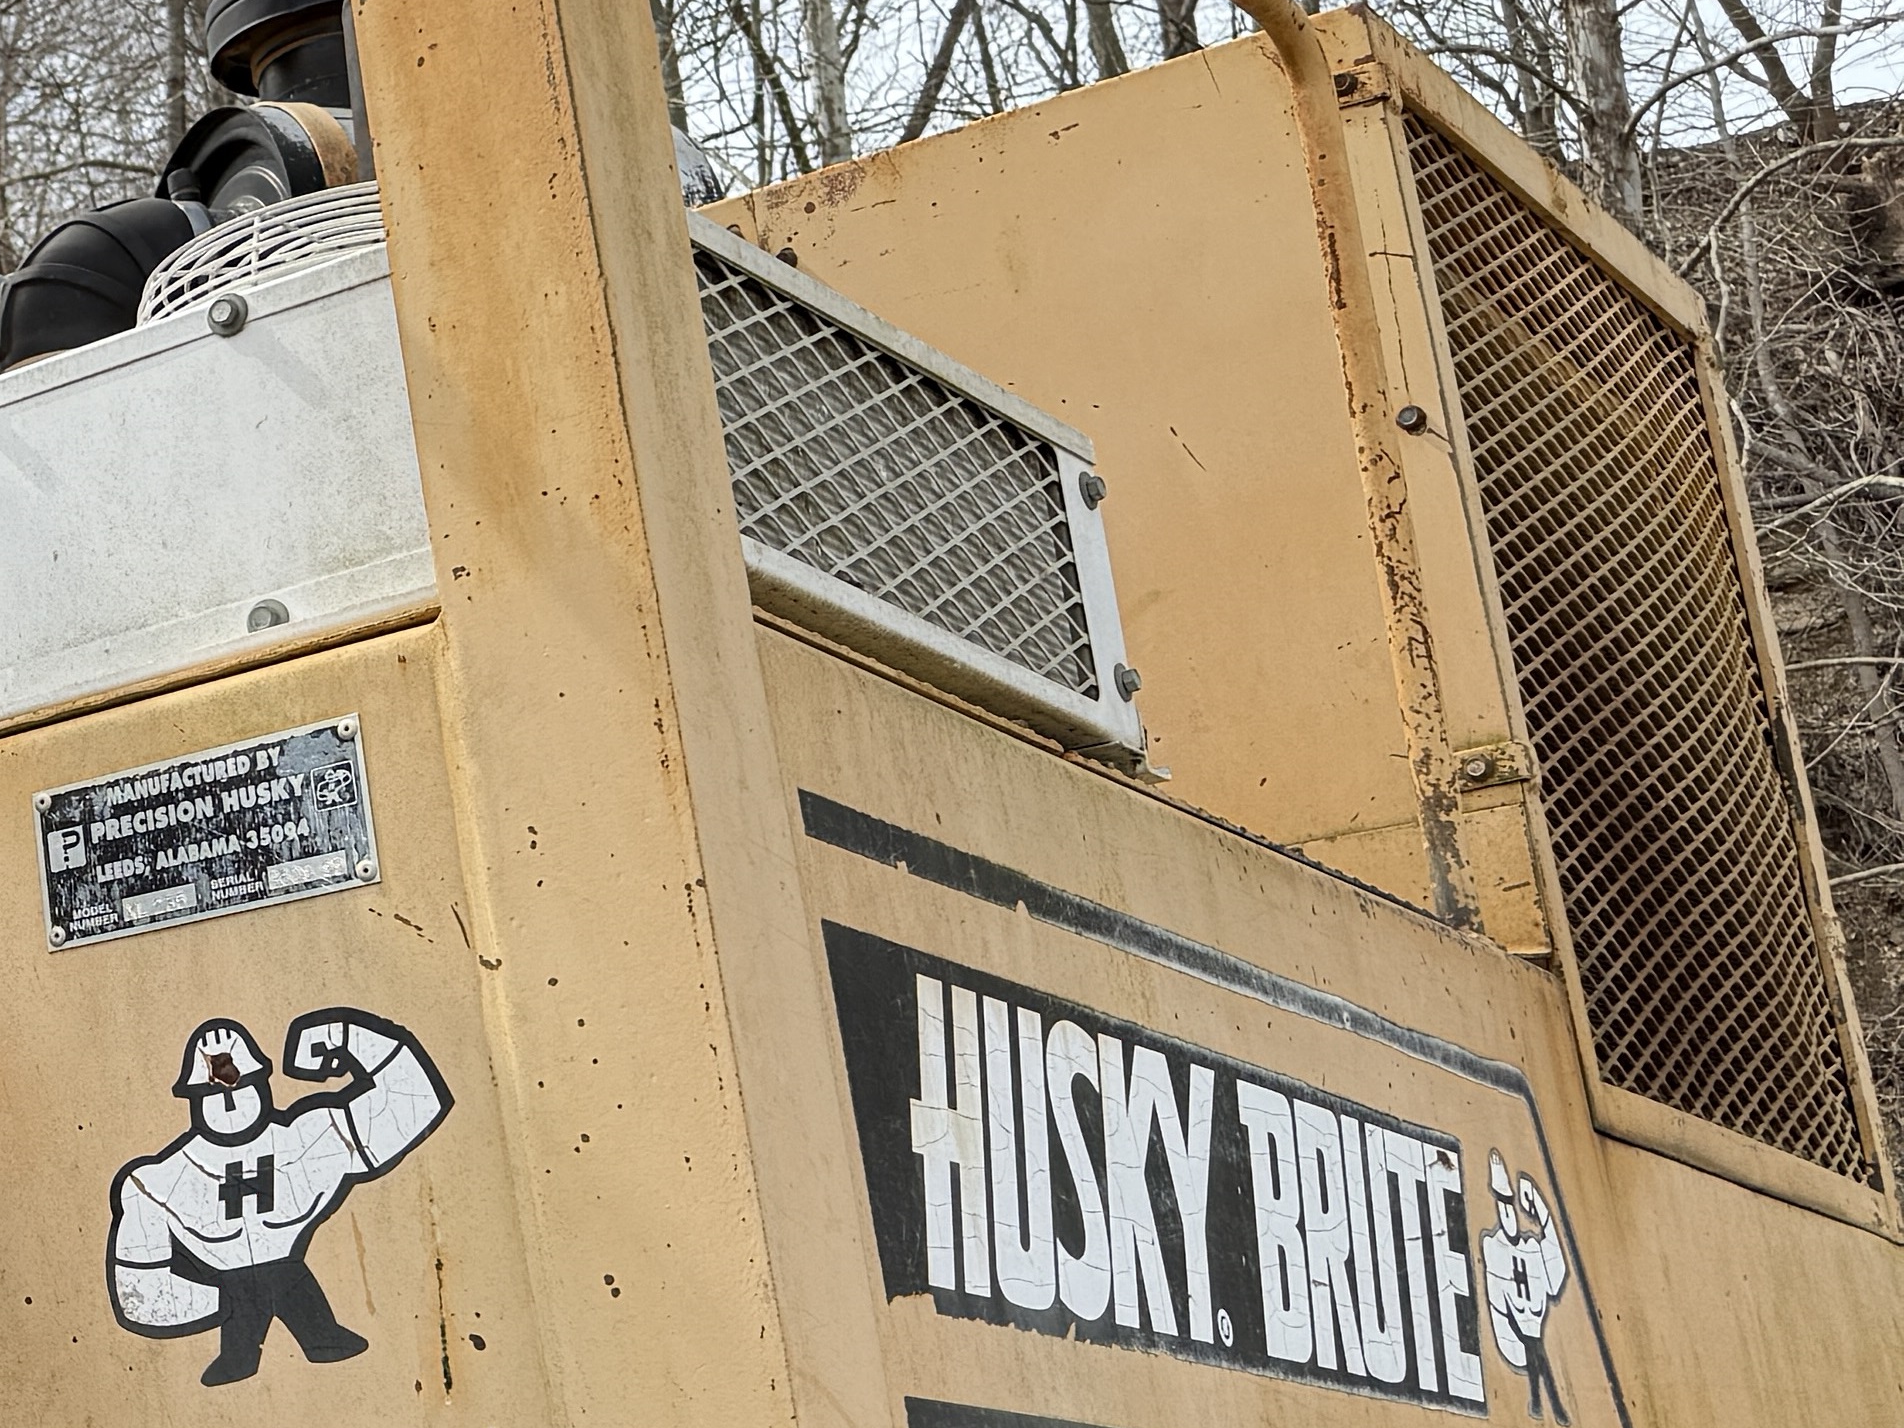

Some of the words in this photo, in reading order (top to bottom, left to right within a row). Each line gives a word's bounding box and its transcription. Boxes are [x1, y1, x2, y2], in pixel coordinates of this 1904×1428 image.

[105, 754, 251, 807] MANUFACTURED
[255, 745, 282, 771] BY
[90, 796, 215, 844] PRECISION
[222, 774, 305, 814] HUSKY
[96, 855, 152, 884] LEEDS,
[155, 834, 242, 871] ALABAMA
[245, 817, 310, 850] 35094
[72, 903, 114, 921] MODEL
[210, 874, 255, 890] SERIAL
[211, 881, 264, 902] NUMBER
[69, 912, 119, 933] NUMBER
[219, 1154, 274, 1221] H
[909, 973, 1215, 1344] HUSKY
[1236, 1078, 1485, 1403] BRUTE
